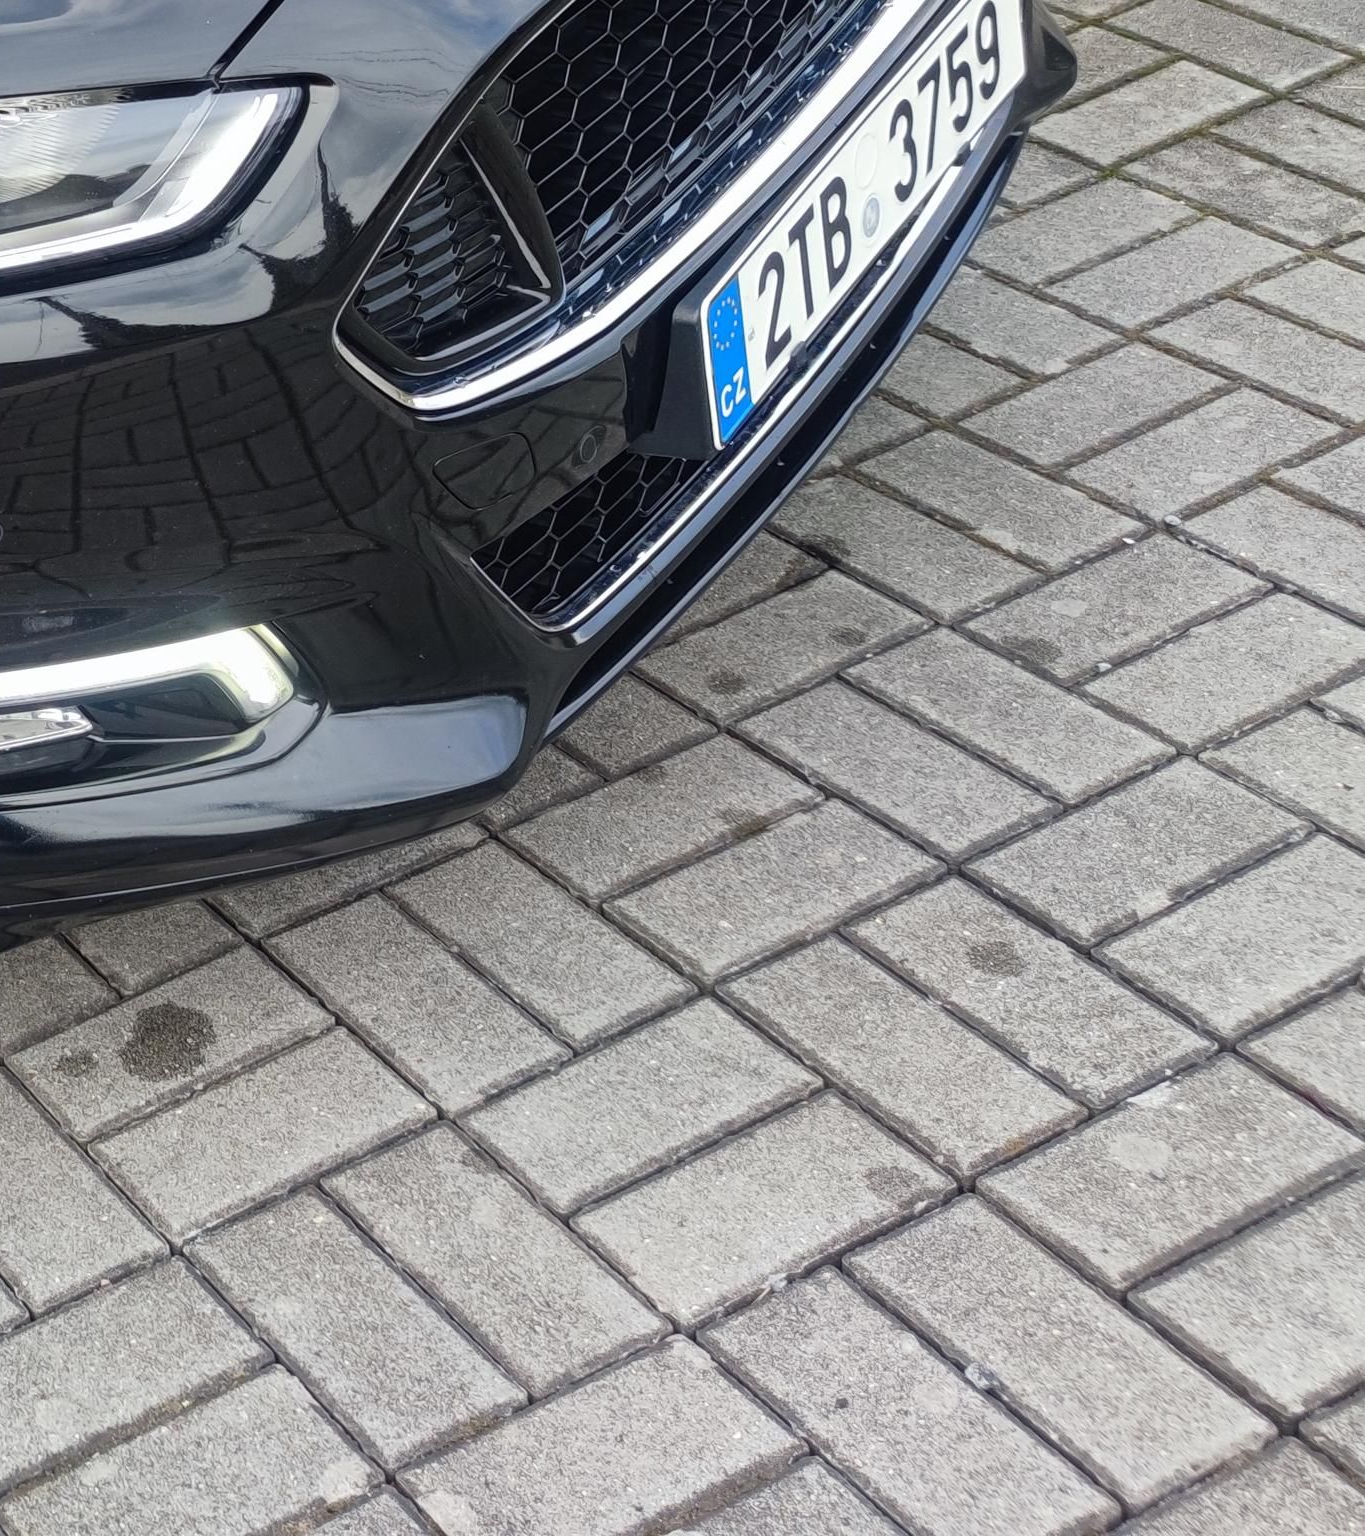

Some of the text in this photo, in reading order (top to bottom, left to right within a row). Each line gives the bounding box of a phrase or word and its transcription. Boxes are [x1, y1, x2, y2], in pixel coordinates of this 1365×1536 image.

[757, 0, 1001, 369] 2TB 3759
[721, 366, 747, 418] CZ
